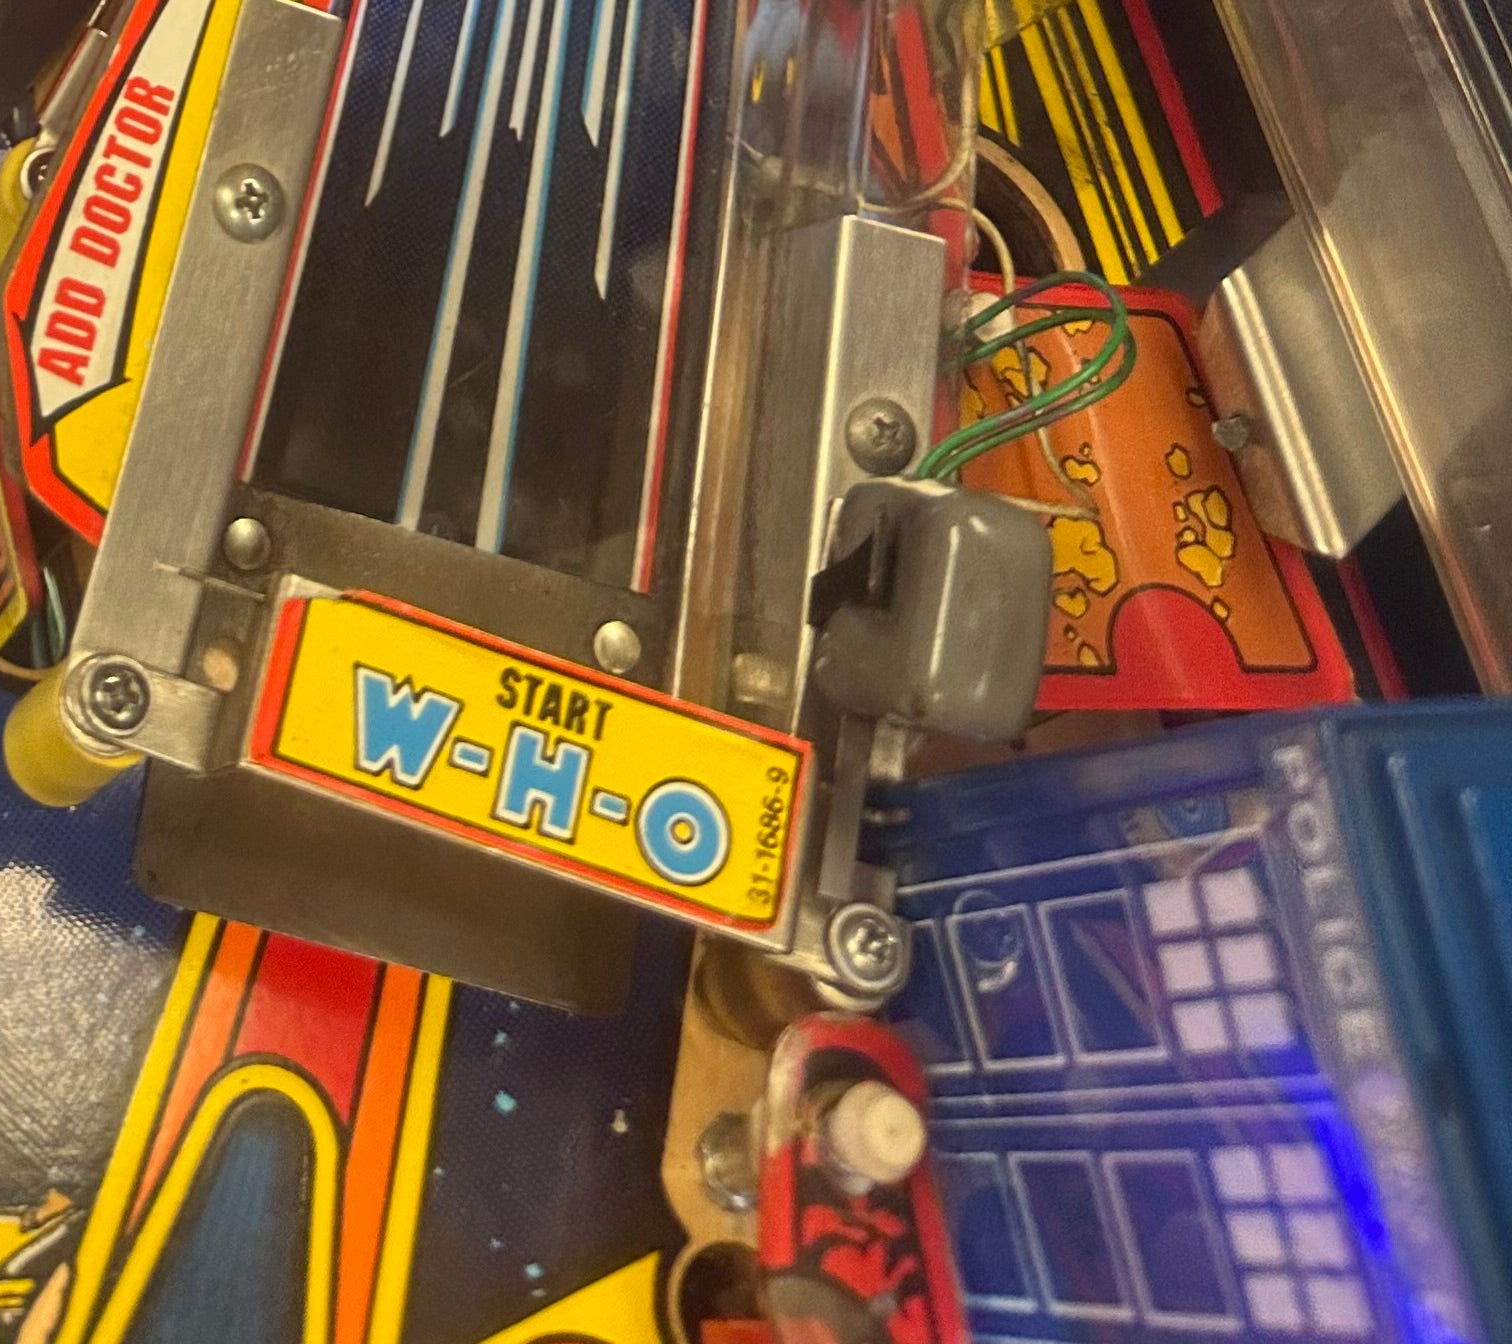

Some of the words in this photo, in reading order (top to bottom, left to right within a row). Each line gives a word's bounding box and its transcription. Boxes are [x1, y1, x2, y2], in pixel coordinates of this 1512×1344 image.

[37, 276, 107, 385] ADD
[72, 75, 176, 270] DOCTOR
[354, 662, 732, 887] W-H-O
[496, 668, 614, 742] START
[746, 764, 790, 908] 31-1686-9
